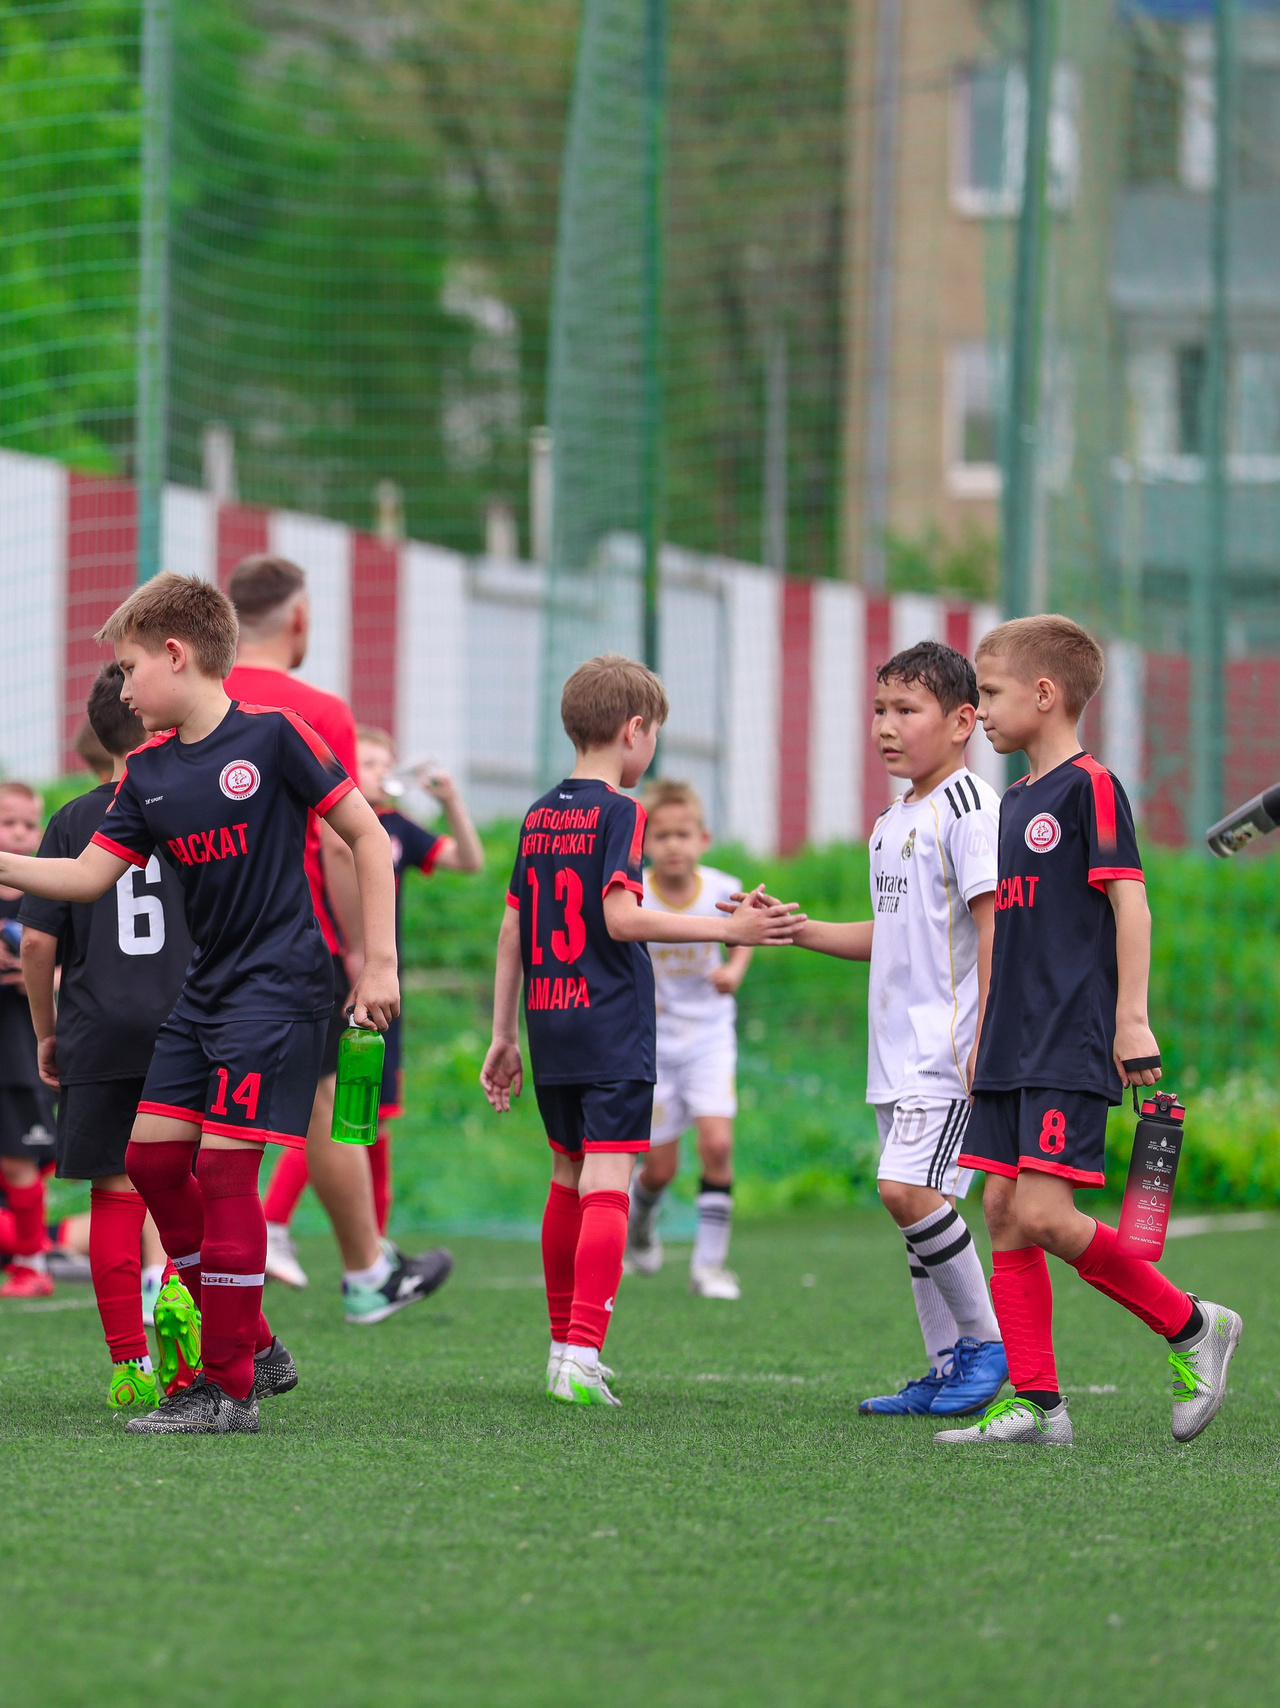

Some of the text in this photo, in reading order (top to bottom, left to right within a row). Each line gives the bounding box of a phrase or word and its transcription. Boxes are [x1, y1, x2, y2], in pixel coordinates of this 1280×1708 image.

[524, 806, 600, 831] ФУТБОЛЬНЫЙ
[167, 822, 248, 867] РАСКАТ
[521, 833, 596, 857] ЦЕНТР РАСКАТ
[875, 870, 908, 894] irates
[116, 853, 166, 956] 6
[526, 867, 587, 965] 13
[877, 895, 900, 913] BETTER
[528, 976, 591, 1010] АМАРА
[210, 1067, 261, 1119] 14
[891, 1105, 927, 1146] 10
[1038, 1108, 1067, 1155] 8
